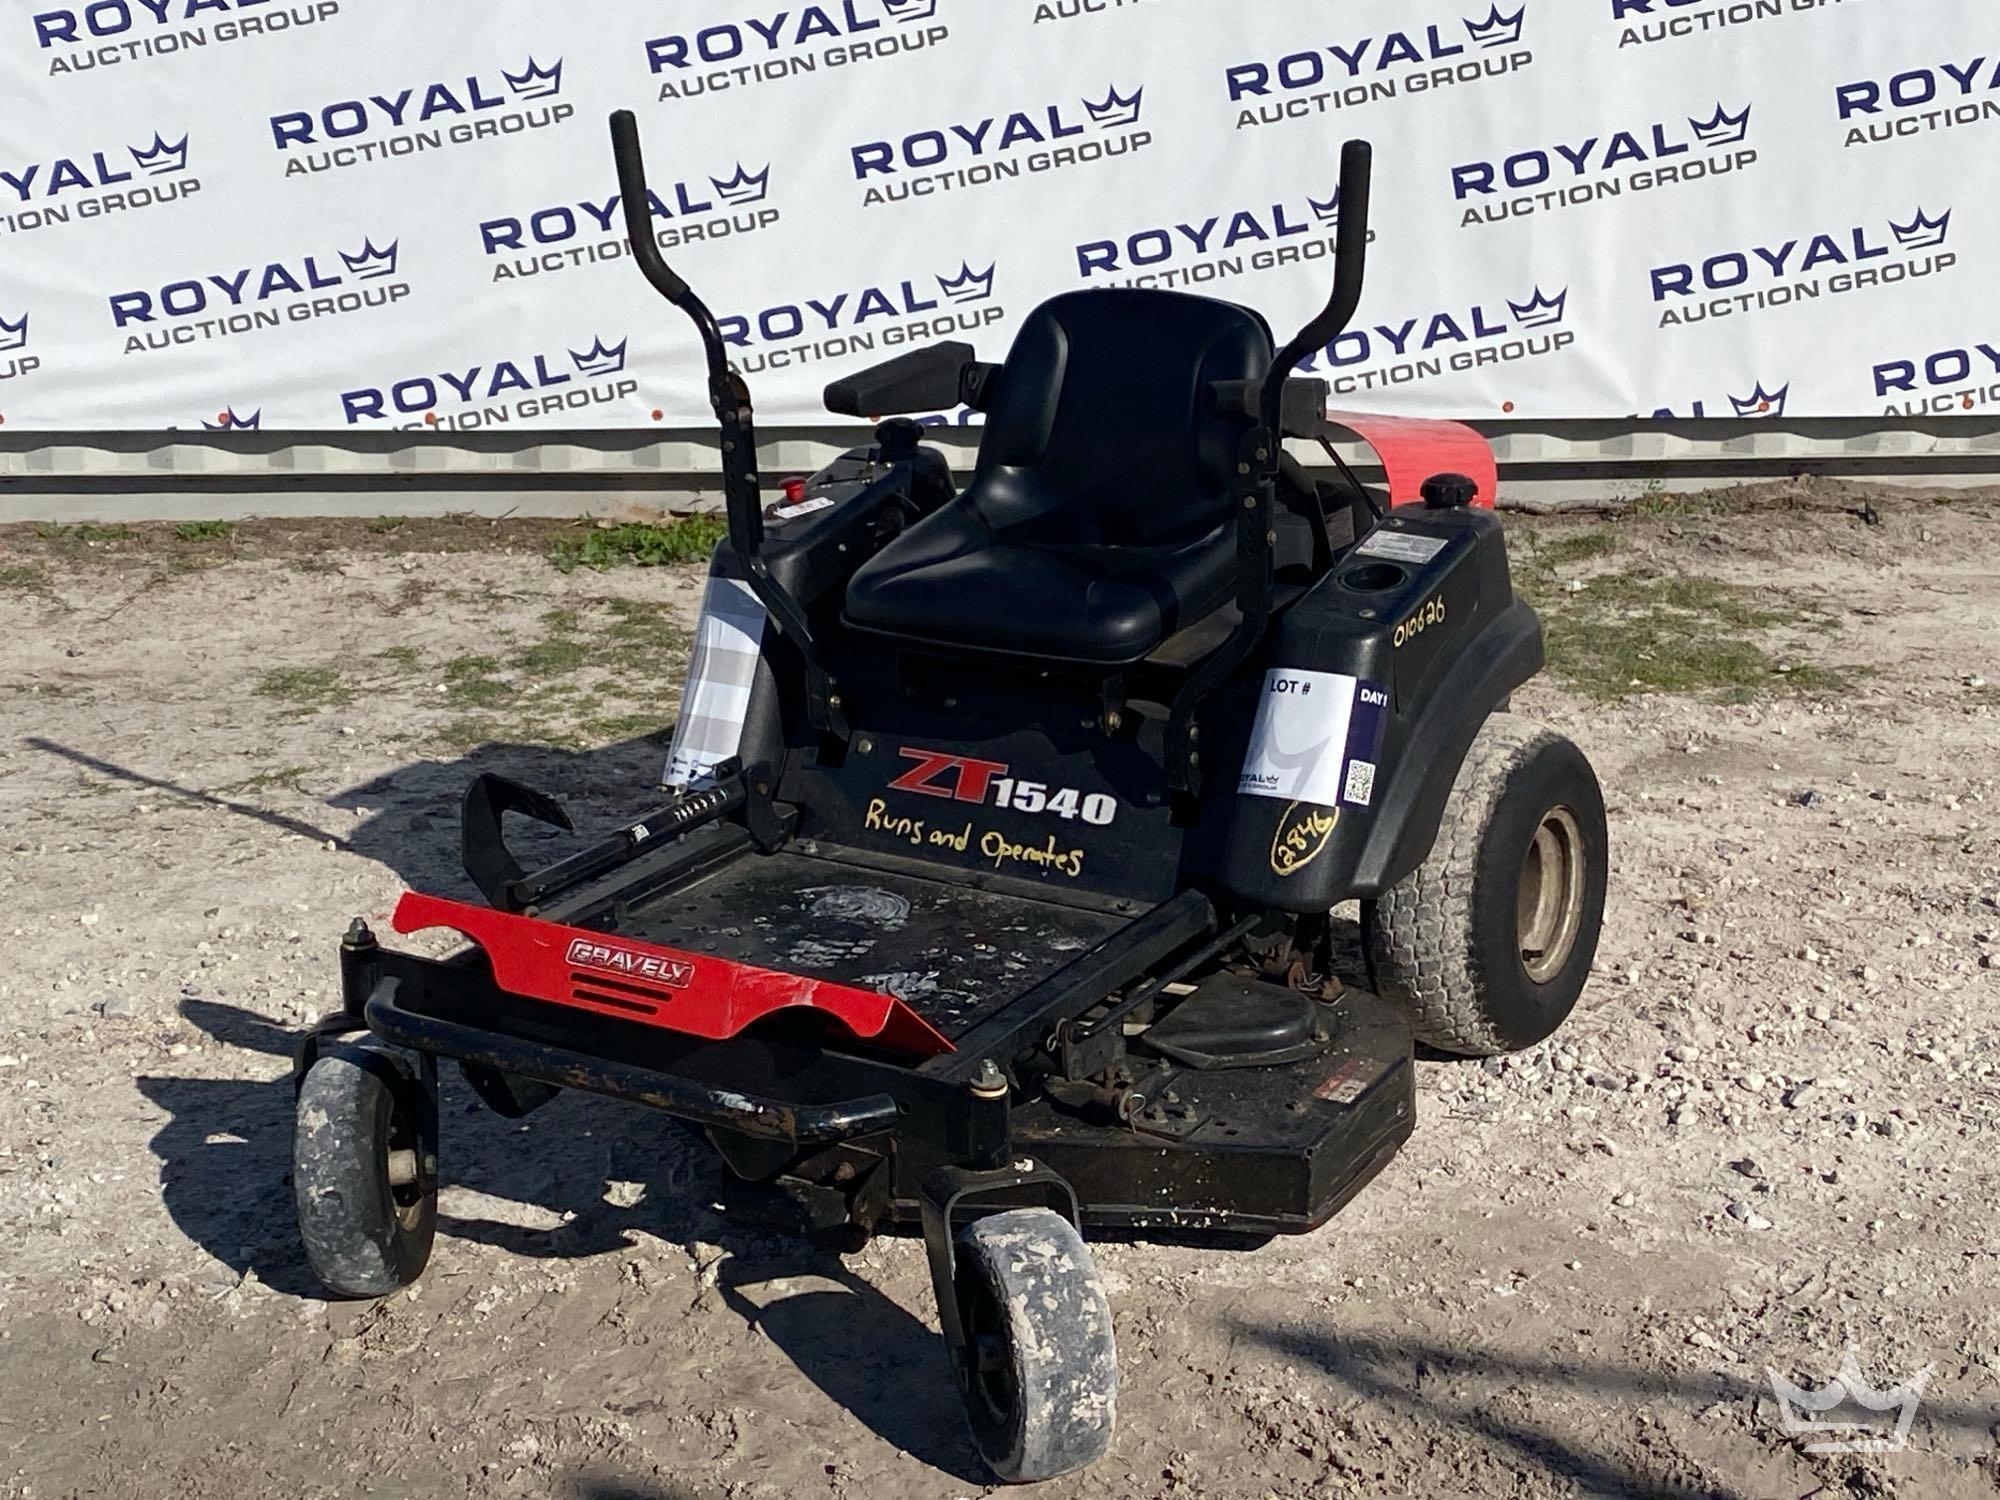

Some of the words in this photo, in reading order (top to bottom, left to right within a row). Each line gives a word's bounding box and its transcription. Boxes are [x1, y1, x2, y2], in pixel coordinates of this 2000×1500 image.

[49, 27, 206, 76] AUCTION
[214, 1, 339, 42] GROUP
[645, 0, 880, 73] ROYAL
[1618, 0, 1782, 48] AUCTION
[657, 54, 816, 102] AUCTION
[824, 26, 949, 68] GROUP
[1226, 25, 1465, 100] ROYAL
[1236, 80, 1395, 129] AUCTION
[1405, 50, 1531, 94] GROUP
[1836, 57, 2000, 119] ROY
[270, 76, 504, 150] ROYAL
[285, 129, 442, 177] AUCTION
[449, 103, 574, 145] GROUP
[850, 105, 1083, 178] ROYAL
[862, 158, 1019, 207] AUCTION
[1028, 131, 1152, 173] GROUP
[1452, 124, 1688, 199] ROYAL
[1460, 178, 1621, 228] AUCTION
[1630, 149, 1757, 191] GROUP
[77, 179, 201, 218] GROUP
[493, 239, 633, 282] AUCTIO
[657, 209, 780, 248] GROUP
[1076, 203, 1309, 277] ROYAL
[1650, 226, 1888, 302] ROYAL
[109, 256, 343, 328] ROYAL
[124, 308, 280, 354] AUCTION
[288, 283, 411, 321] GROUP
[882, 306, 1004, 346] GROUP
[1658, 279, 1819, 328] AUCTION
[1829, 252, 1957, 294] GROUP
[1449, 332, 1574, 371] GROUP
[341, 355, 571, 424] ROYAL
[517, 379, 638, 418] GROUP
[1394, 594, 1445, 648] 010626
[1270, 679, 1299, 694] LOT
[1301, 682, 1311, 695] #
[864, 798, 922, 845] Runs
[929, 822, 973, 851] and
[980, 831, 1085, 877] Operates
[1277, 809, 1333, 867] 2846
[571, 942, 691, 981] GRAVELY
